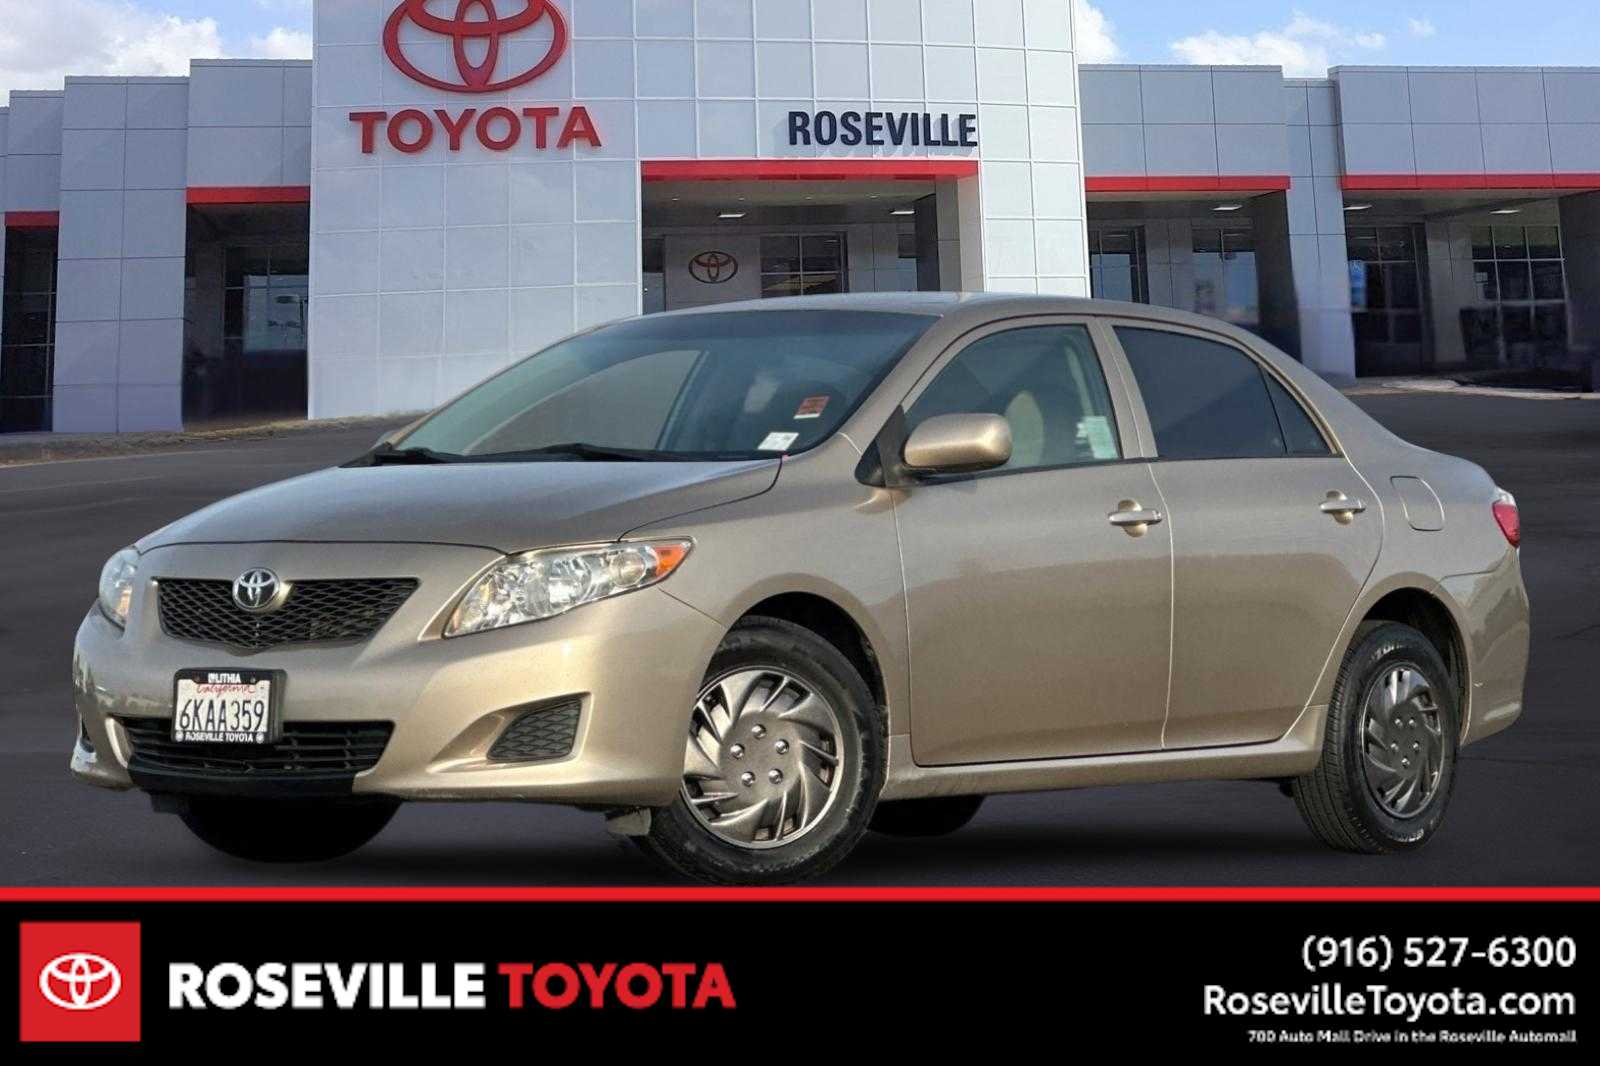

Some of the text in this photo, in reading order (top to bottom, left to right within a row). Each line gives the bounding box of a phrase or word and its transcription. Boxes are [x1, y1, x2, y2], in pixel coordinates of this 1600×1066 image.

[349, 105, 602, 154] TOYOTA
[788, 110, 978, 147] ROSEVILLE
[197, 683, 256, 698] California
[179, 699, 265, 732] 6KAA359
[185, 732, 254, 743] ROSEVILLE TOYOTA
